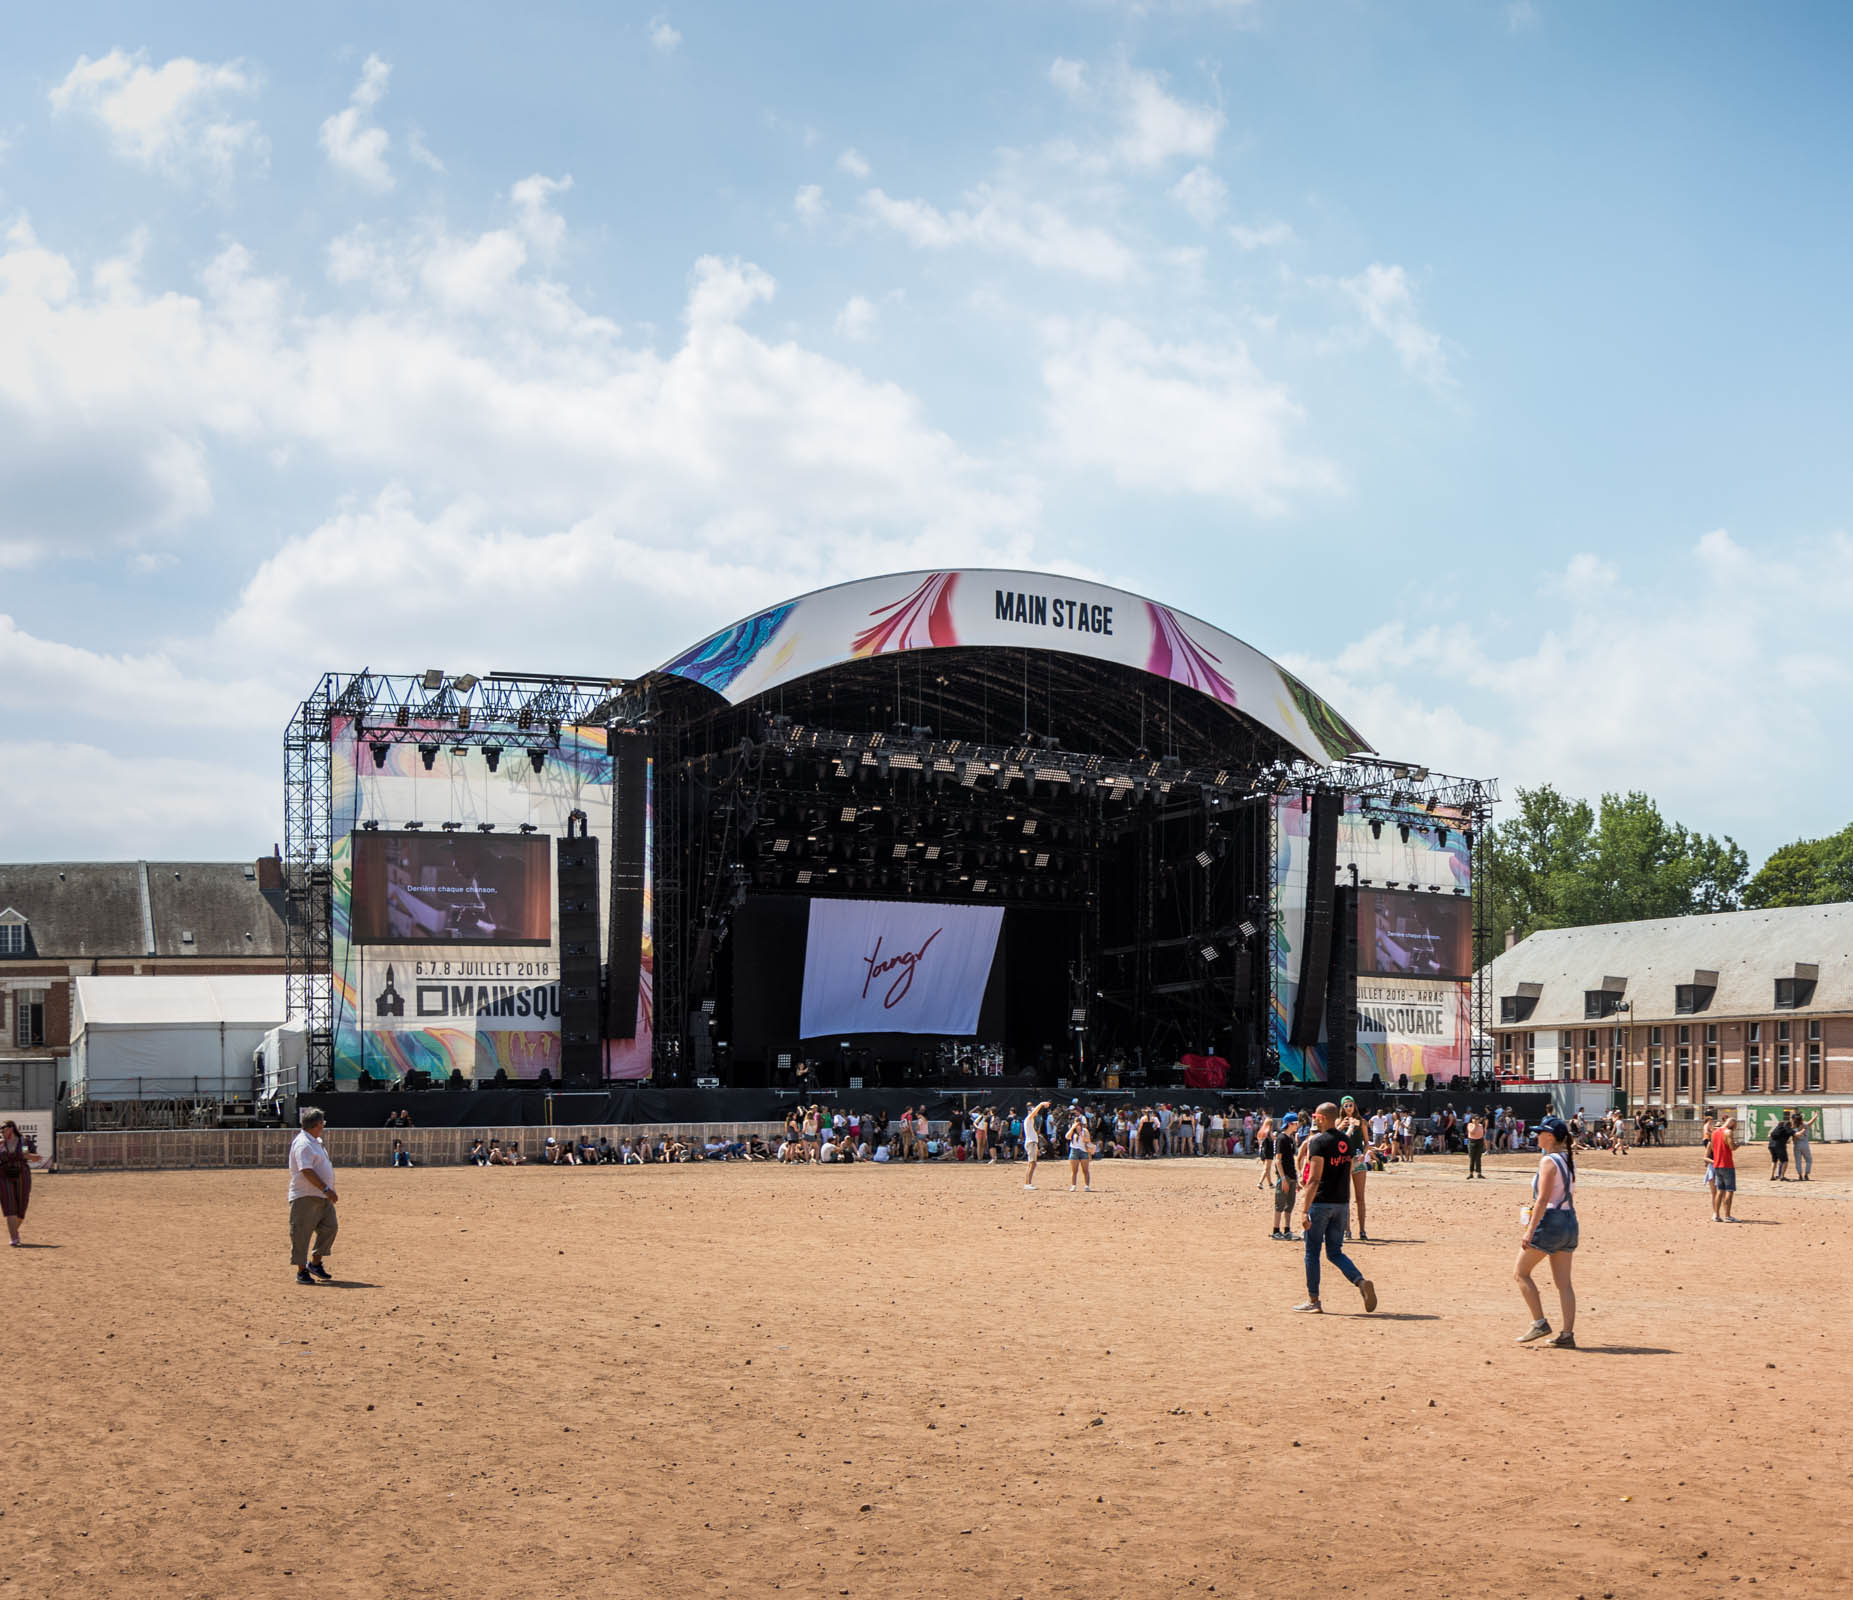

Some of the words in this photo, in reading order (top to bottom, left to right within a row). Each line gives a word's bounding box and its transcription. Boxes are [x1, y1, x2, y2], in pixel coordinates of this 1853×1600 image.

[995, 590, 1047, 625] MAIN
[1052, 599, 1113, 635] STAGE
[416, 961, 450, 975] 6.7.8
[458, 961, 510, 976] JUILLET
[517, 962, 549, 976] 2018
[1386, 989, 1405, 1001] 2018
[1417, 991, 1444, 1003] ARRAS
